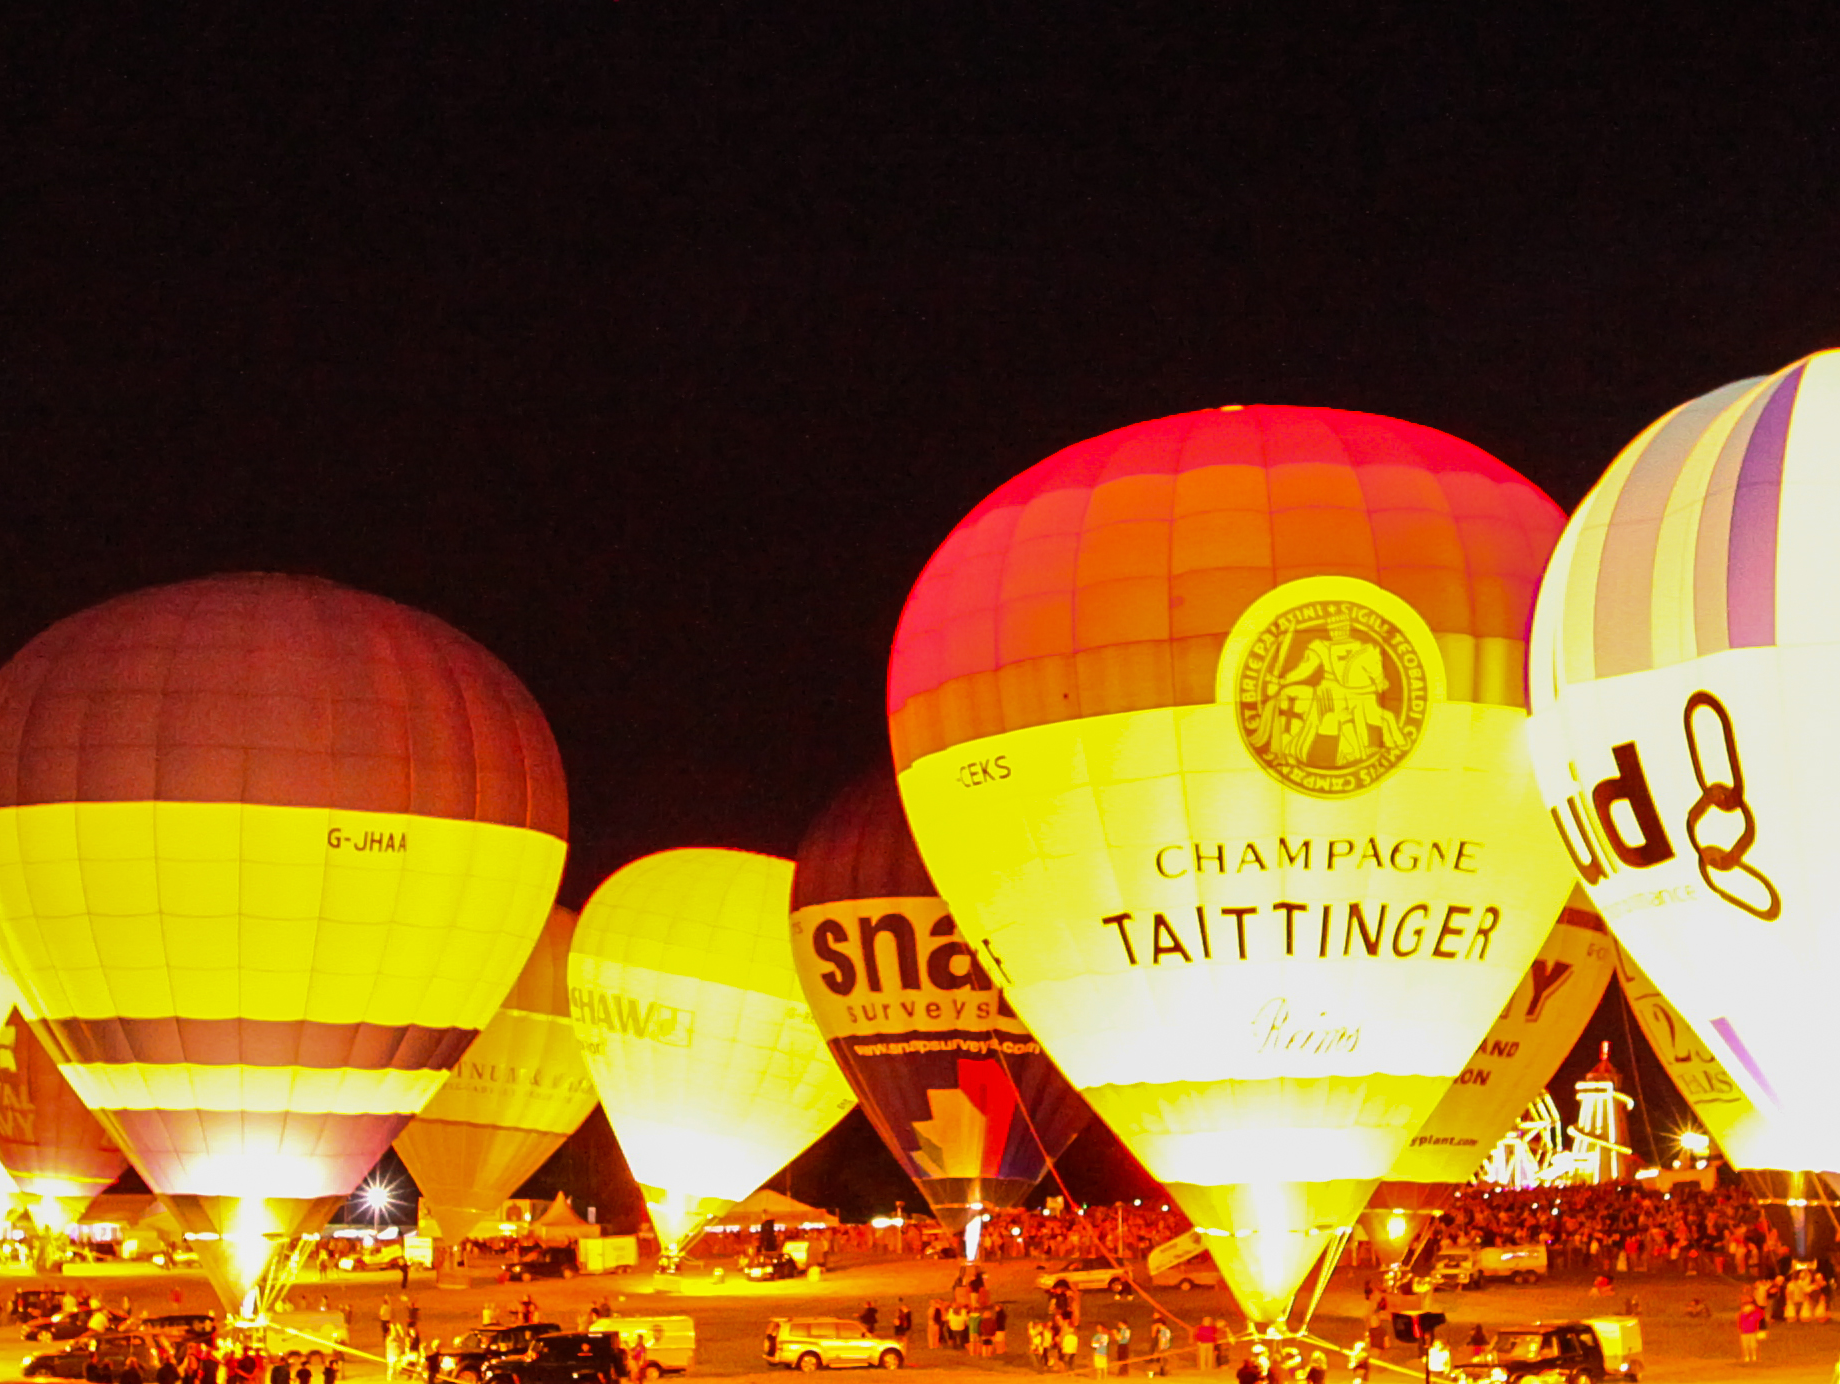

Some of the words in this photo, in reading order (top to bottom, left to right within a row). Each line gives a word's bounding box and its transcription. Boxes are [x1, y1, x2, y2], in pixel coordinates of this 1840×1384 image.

[327, 828, 408, 853] G-JHAA
[1154, 836, 1484, 880] CHAMPAGNE
[1100, 901, 1502, 966] TAITTINGER
[845, 998, 992, 1025] surveys
